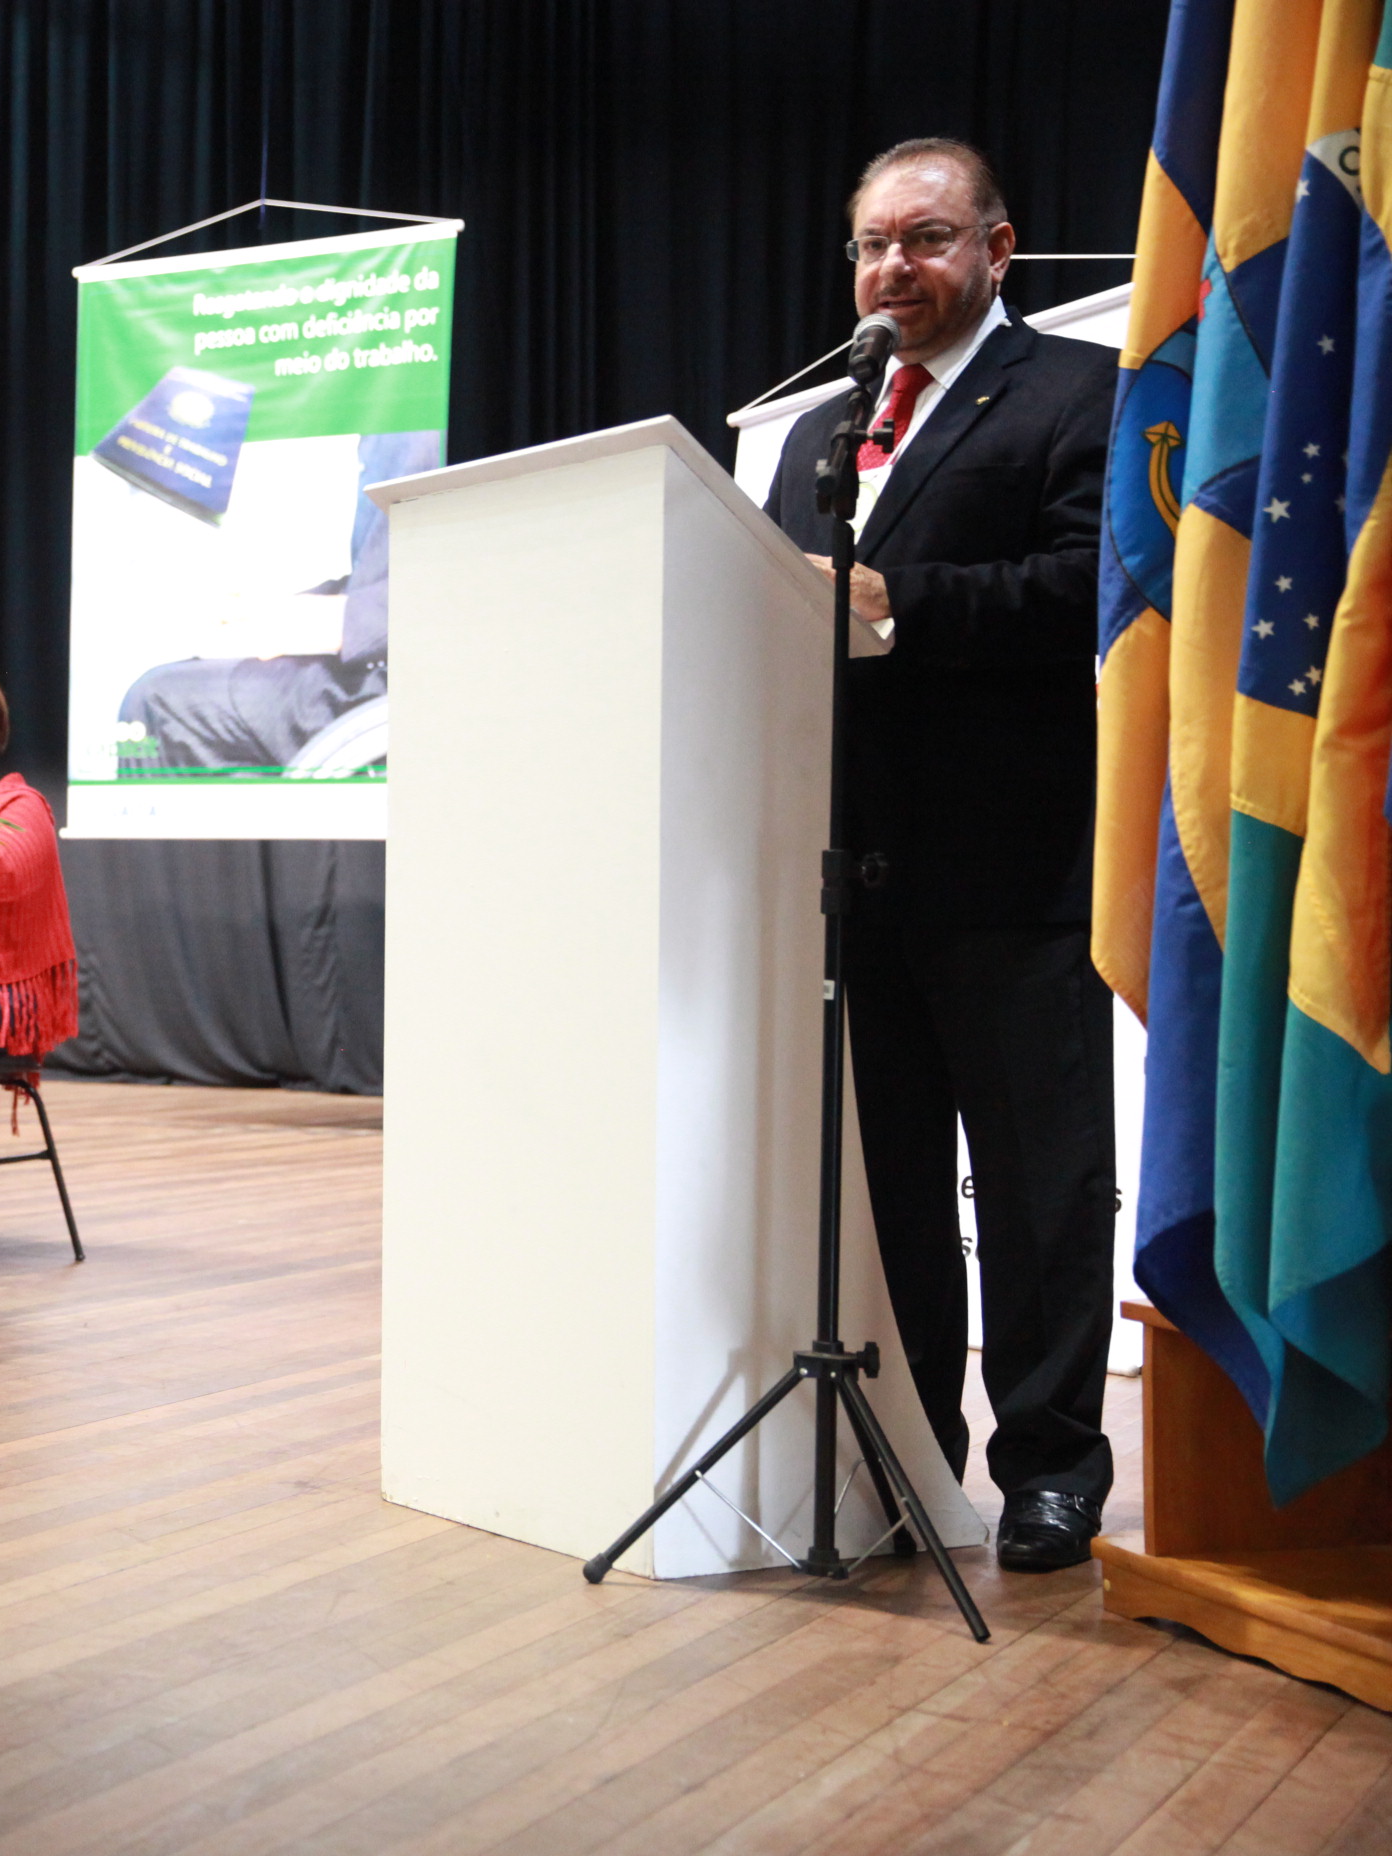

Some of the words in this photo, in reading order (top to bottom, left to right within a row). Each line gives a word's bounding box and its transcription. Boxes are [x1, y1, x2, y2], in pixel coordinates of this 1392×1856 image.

[414, 266, 440, 291] da
[195, 326, 256, 356] pessoa
[259, 322, 299, 343] com
[404, 307, 440, 333] por
[275, 351, 322, 376] meio
[323, 347, 350, 372] do
[353, 339, 439, 369] trabalho.
